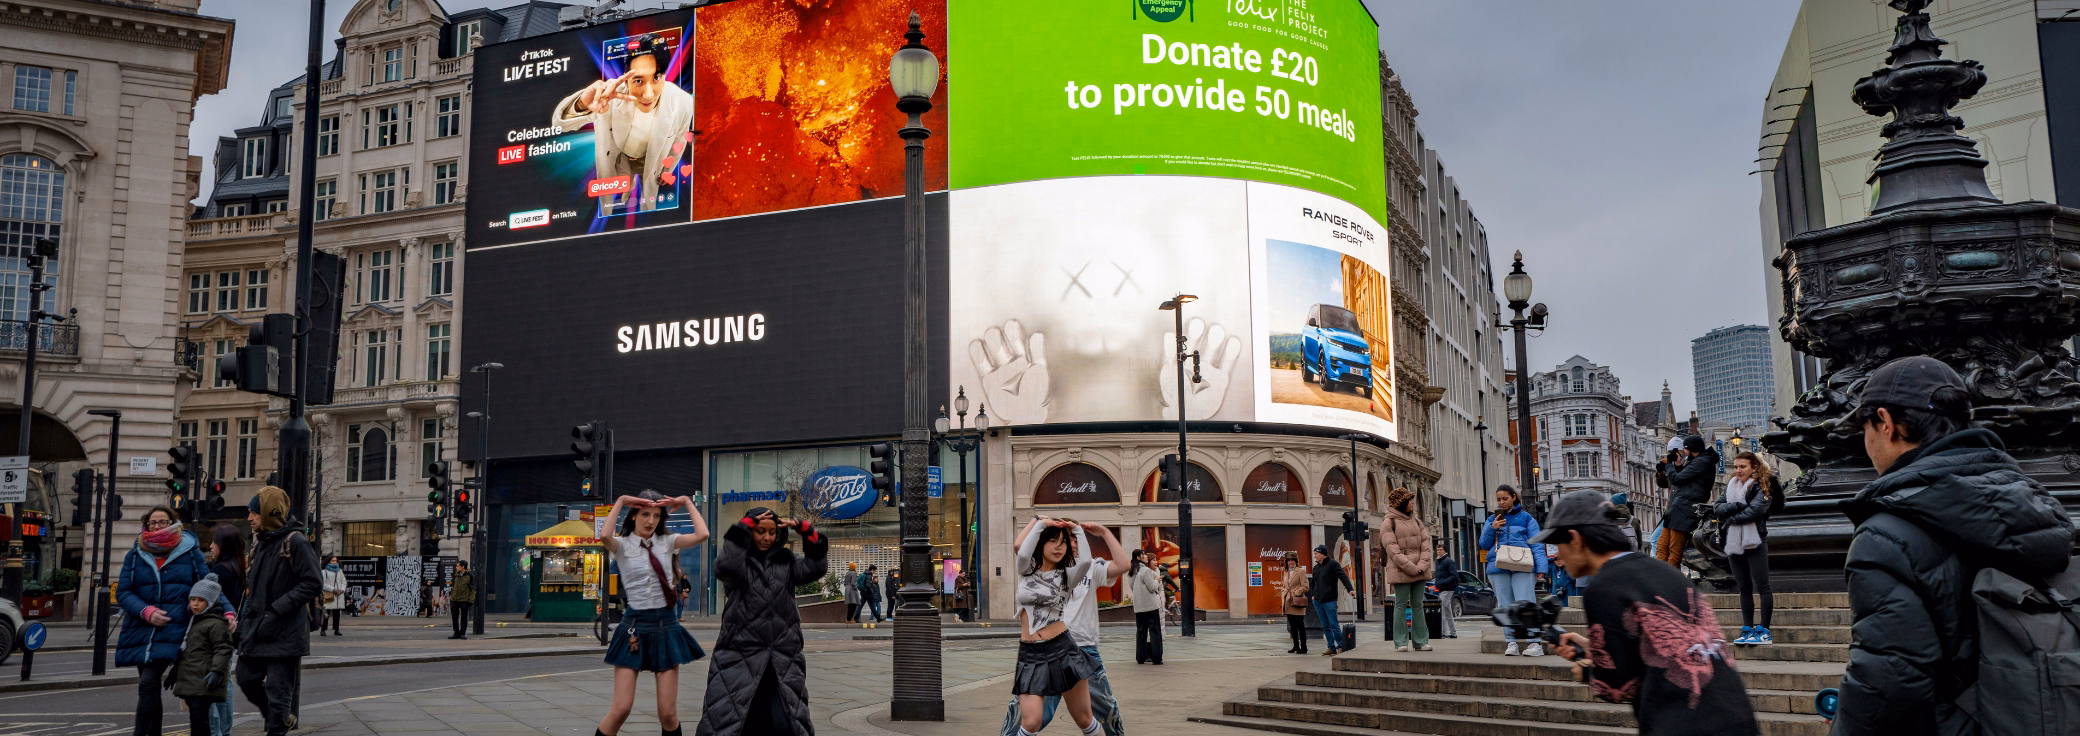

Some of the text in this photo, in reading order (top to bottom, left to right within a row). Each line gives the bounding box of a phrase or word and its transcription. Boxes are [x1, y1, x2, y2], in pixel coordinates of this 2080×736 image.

[1150, 6, 1175, 14] Appeal
[1288, 7, 1315, 23] FELIX
[1228, 21, 1249, 29] GOOD
[1253, 25, 1272, 33] FOOD
[1290, 33, 1307, 43] GOOD
[1310, 39, 1329, 51] CAUSES
[1288, 18, 1328, 39] PROJECT
[529, 48, 554, 60] TikTok
[1142, 33, 1318, 86] Donate £20
[503, 57, 571, 82] LIVE FEST
[1065, 78, 1356, 143] to provide 50 meals
[507, 125, 563, 142] Celebrate
[501, 140, 571, 161] LIVE fashion
[591, 180, 628, 193] @rico9_c
[488, 220, 507, 228] Search
[560, 211, 577, 219] TikTok
[1302, 207, 1375, 244] RANGE ROVER
[1332, 230, 1363, 248] SPORT
[617, 313, 765, 353] SAMSUNG
[808, 473, 867, 510] Boots
[1057, 481, 1089, 493] Lindt
[1257, 481, 1281, 492] Lindt
[721, 489, 789, 505] pharmacy
[528, 537, 549, 545] HOT
[551, 537, 572, 545] DOG
[540, 585, 560, 593] HOT
